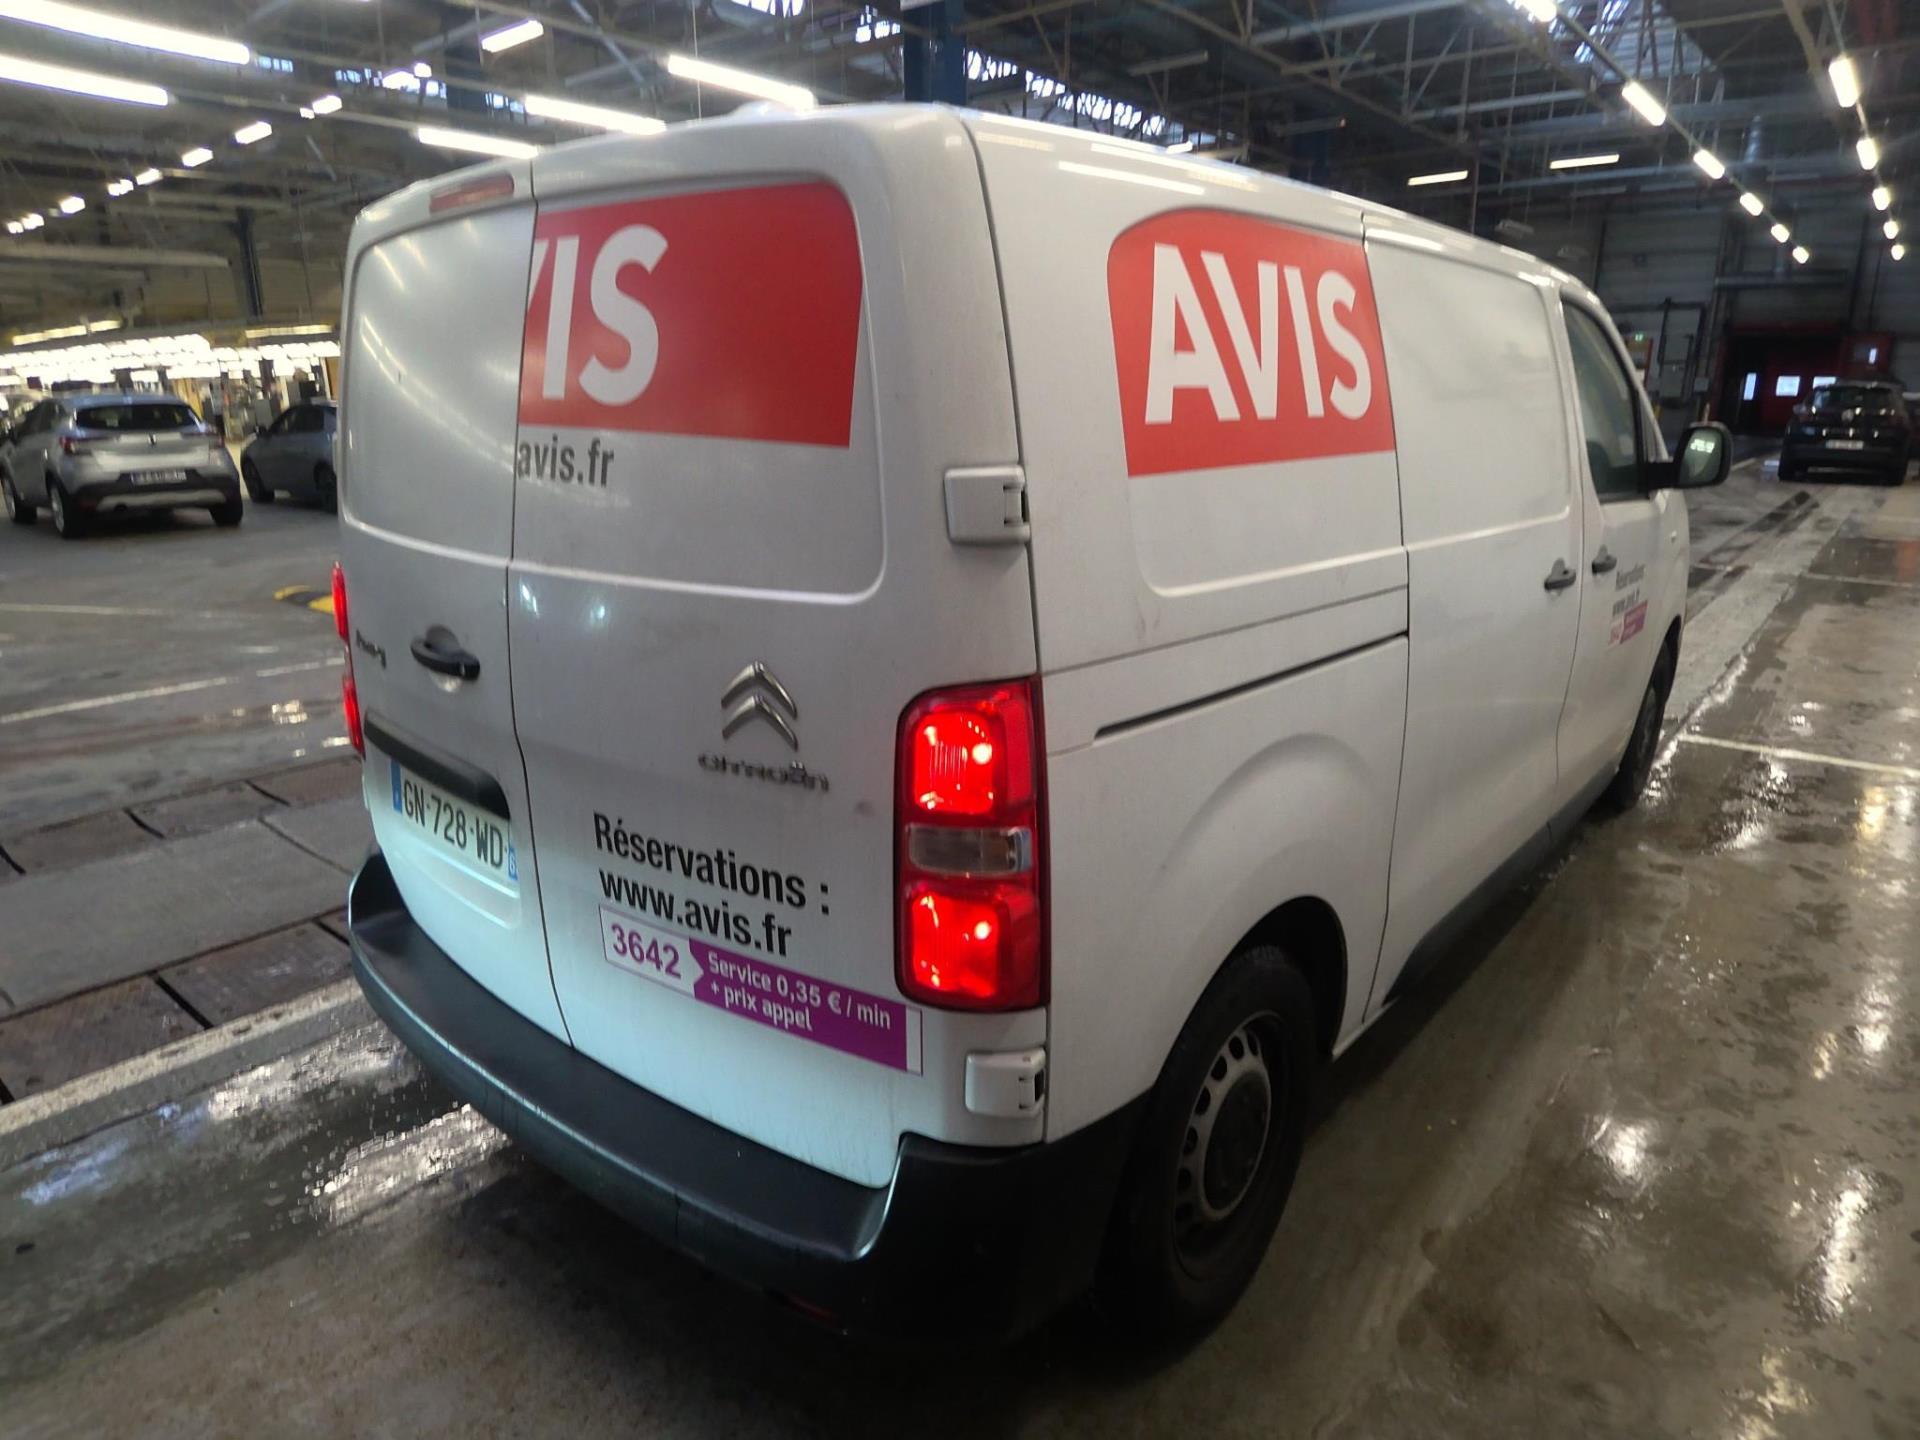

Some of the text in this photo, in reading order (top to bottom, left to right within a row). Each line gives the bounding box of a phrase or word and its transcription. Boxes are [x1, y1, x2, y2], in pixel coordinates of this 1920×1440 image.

[1145, 241, 1372, 425] AVIS
[517, 434, 615, 487] avis.fr
[403, 779, 504, 869] GN-728-WD
[594, 812, 807, 910] Réservations
[599, 868, 792, 957] www.avis.fr
[611, 923, 682, 979] 3642
[708, 952, 772, 993] Service
[776, 974, 822, 1008] 0,35
[828, 991, 842, 1015] €
[857, 1003, 891, 1030] min
[724, 985, 759, 1013] prix
[762, 998, 813, 1033] appel
